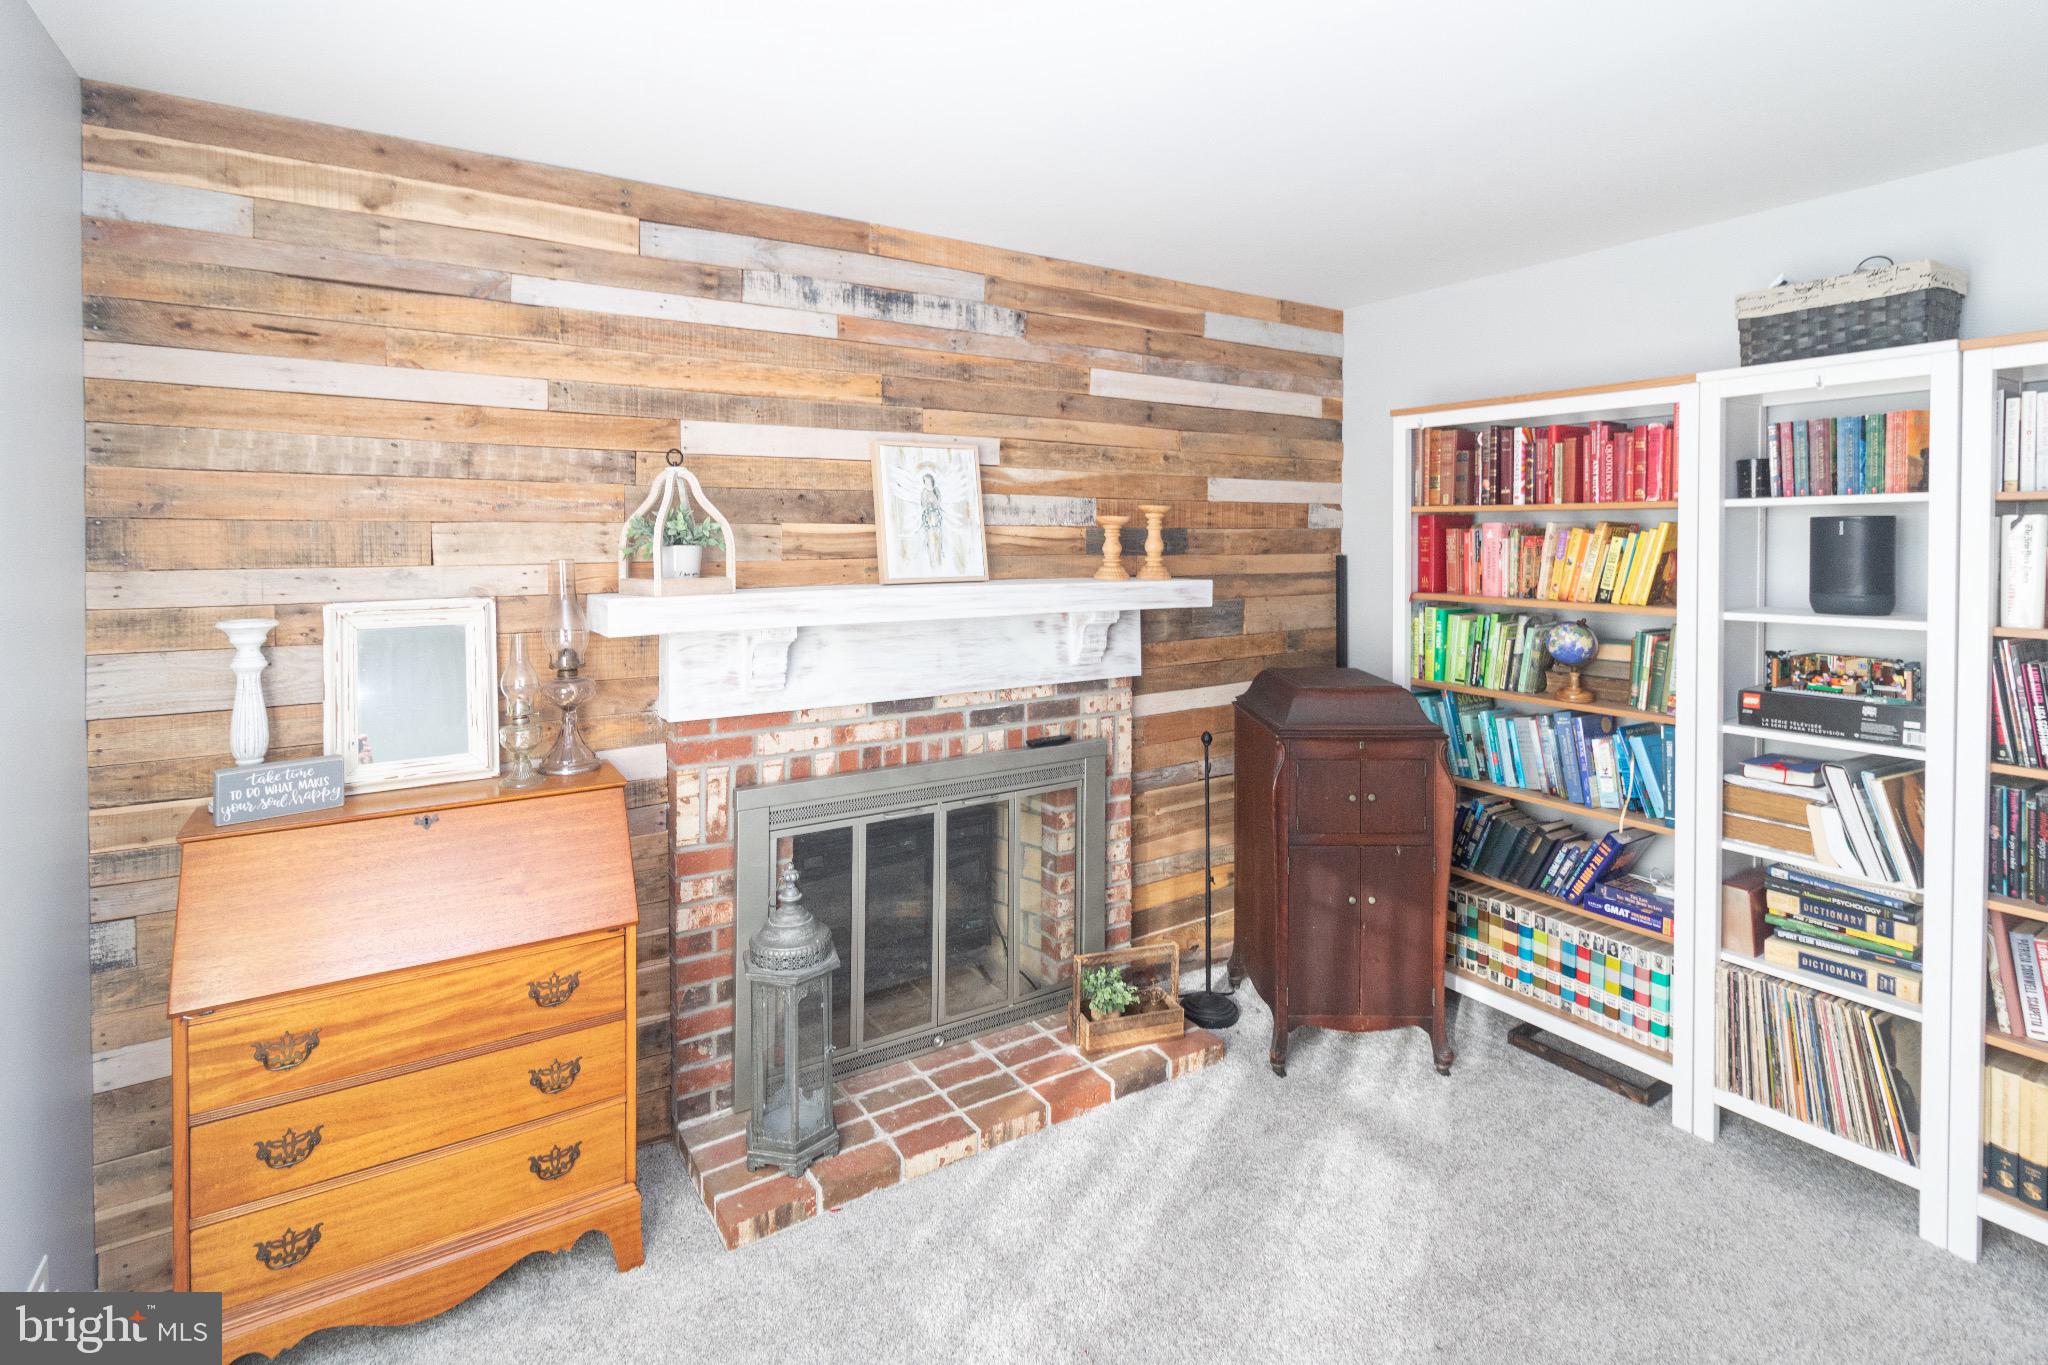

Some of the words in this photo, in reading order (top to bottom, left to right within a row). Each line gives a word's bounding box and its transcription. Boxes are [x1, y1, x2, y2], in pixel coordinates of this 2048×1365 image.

[1605, 444, 1613, 493] QUOTATIONS
[230, 790, 242, 801] TO
[246, 787, 260, 798] DO
[265, 782, 294, 795] WHAT
[298, 776, 330, 789] MAKES
[245, 770, 281, 785] take
[285, 768, 315, 780] time
[221, 801, 256, 822] your
[257, 794, 288, 810] soul
[290, 787, 341, 807] happy
[1602, 902, 1631, 918] GMAT
[1802, 902, 1863, 926] DICTIONARY
[1831, 897, 1881, 915] PSYCHOLOGY
[1800, 957, 1865, 982] DICTIONARY
[2021, 964, 2037, 995] CORNWELL
[2026, 995, 2043, 1028] SCARPETTA
